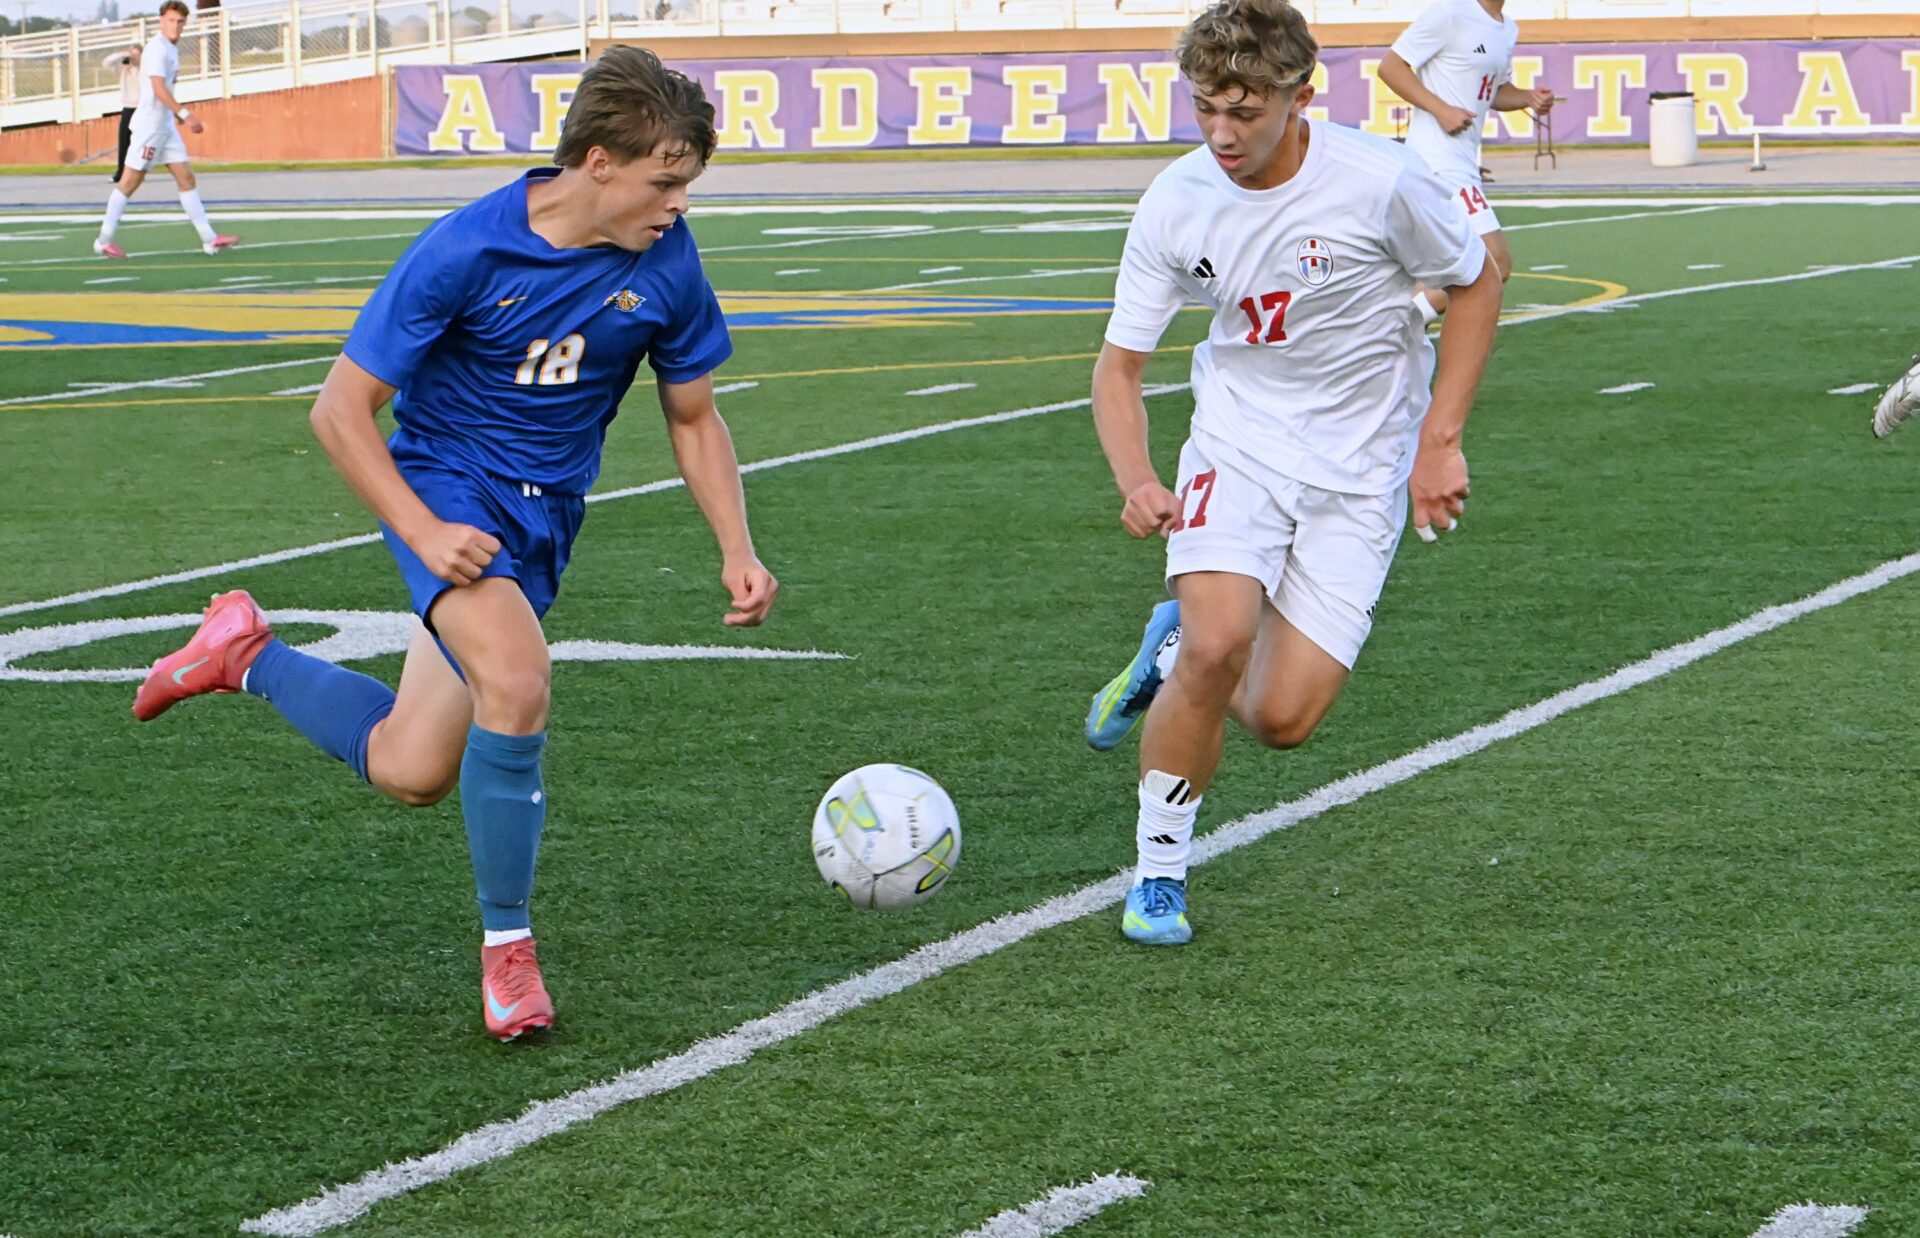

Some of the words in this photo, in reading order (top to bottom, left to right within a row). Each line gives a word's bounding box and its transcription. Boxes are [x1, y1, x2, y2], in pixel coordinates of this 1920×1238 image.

[1459, 185, 1489, 215] 14
[1239, 291, 1291, 344] 17
[514, 333, 586, 385] 18
[1173, 468, 1217, 533] 17
